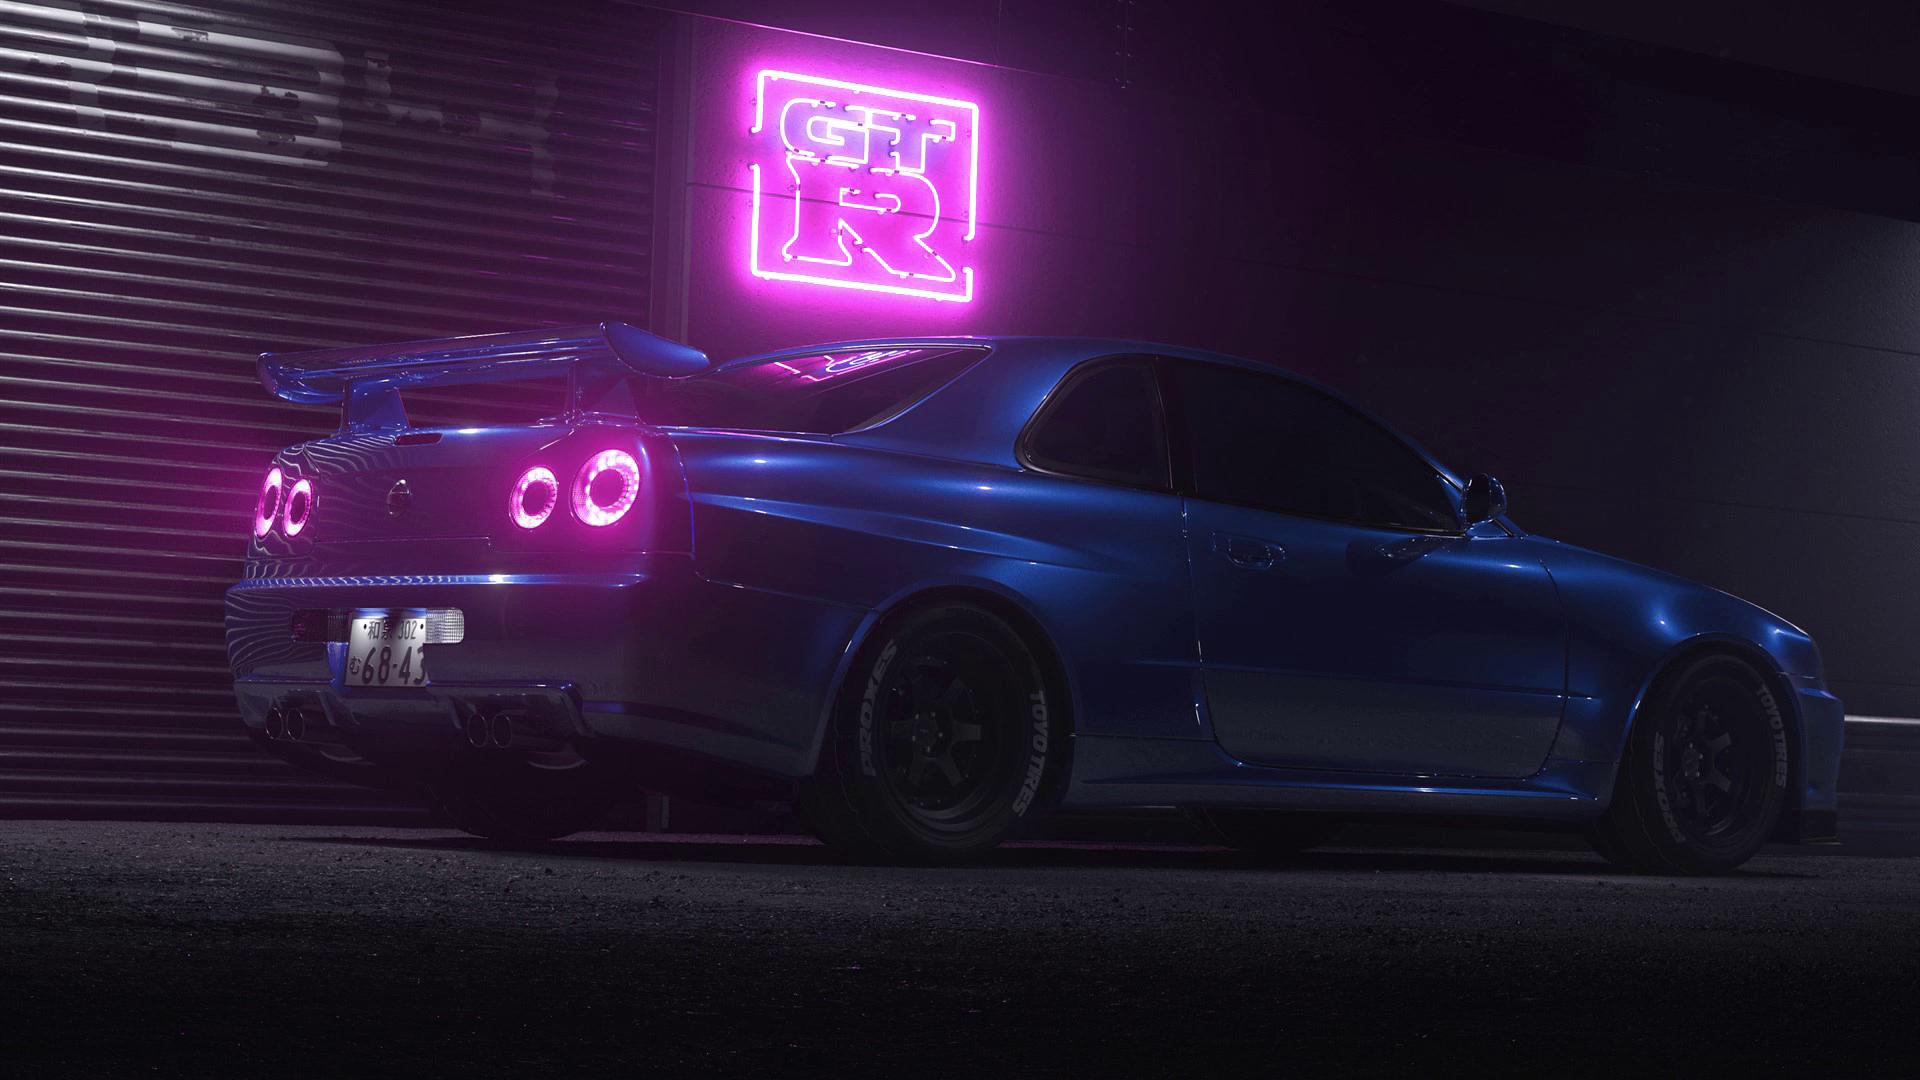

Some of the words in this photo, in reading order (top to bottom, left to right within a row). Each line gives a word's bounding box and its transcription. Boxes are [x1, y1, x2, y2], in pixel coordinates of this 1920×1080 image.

[779, 97, 956, 174] GT
[782, 151, 956, 283] R
[398, 620, 418, 640] 302
